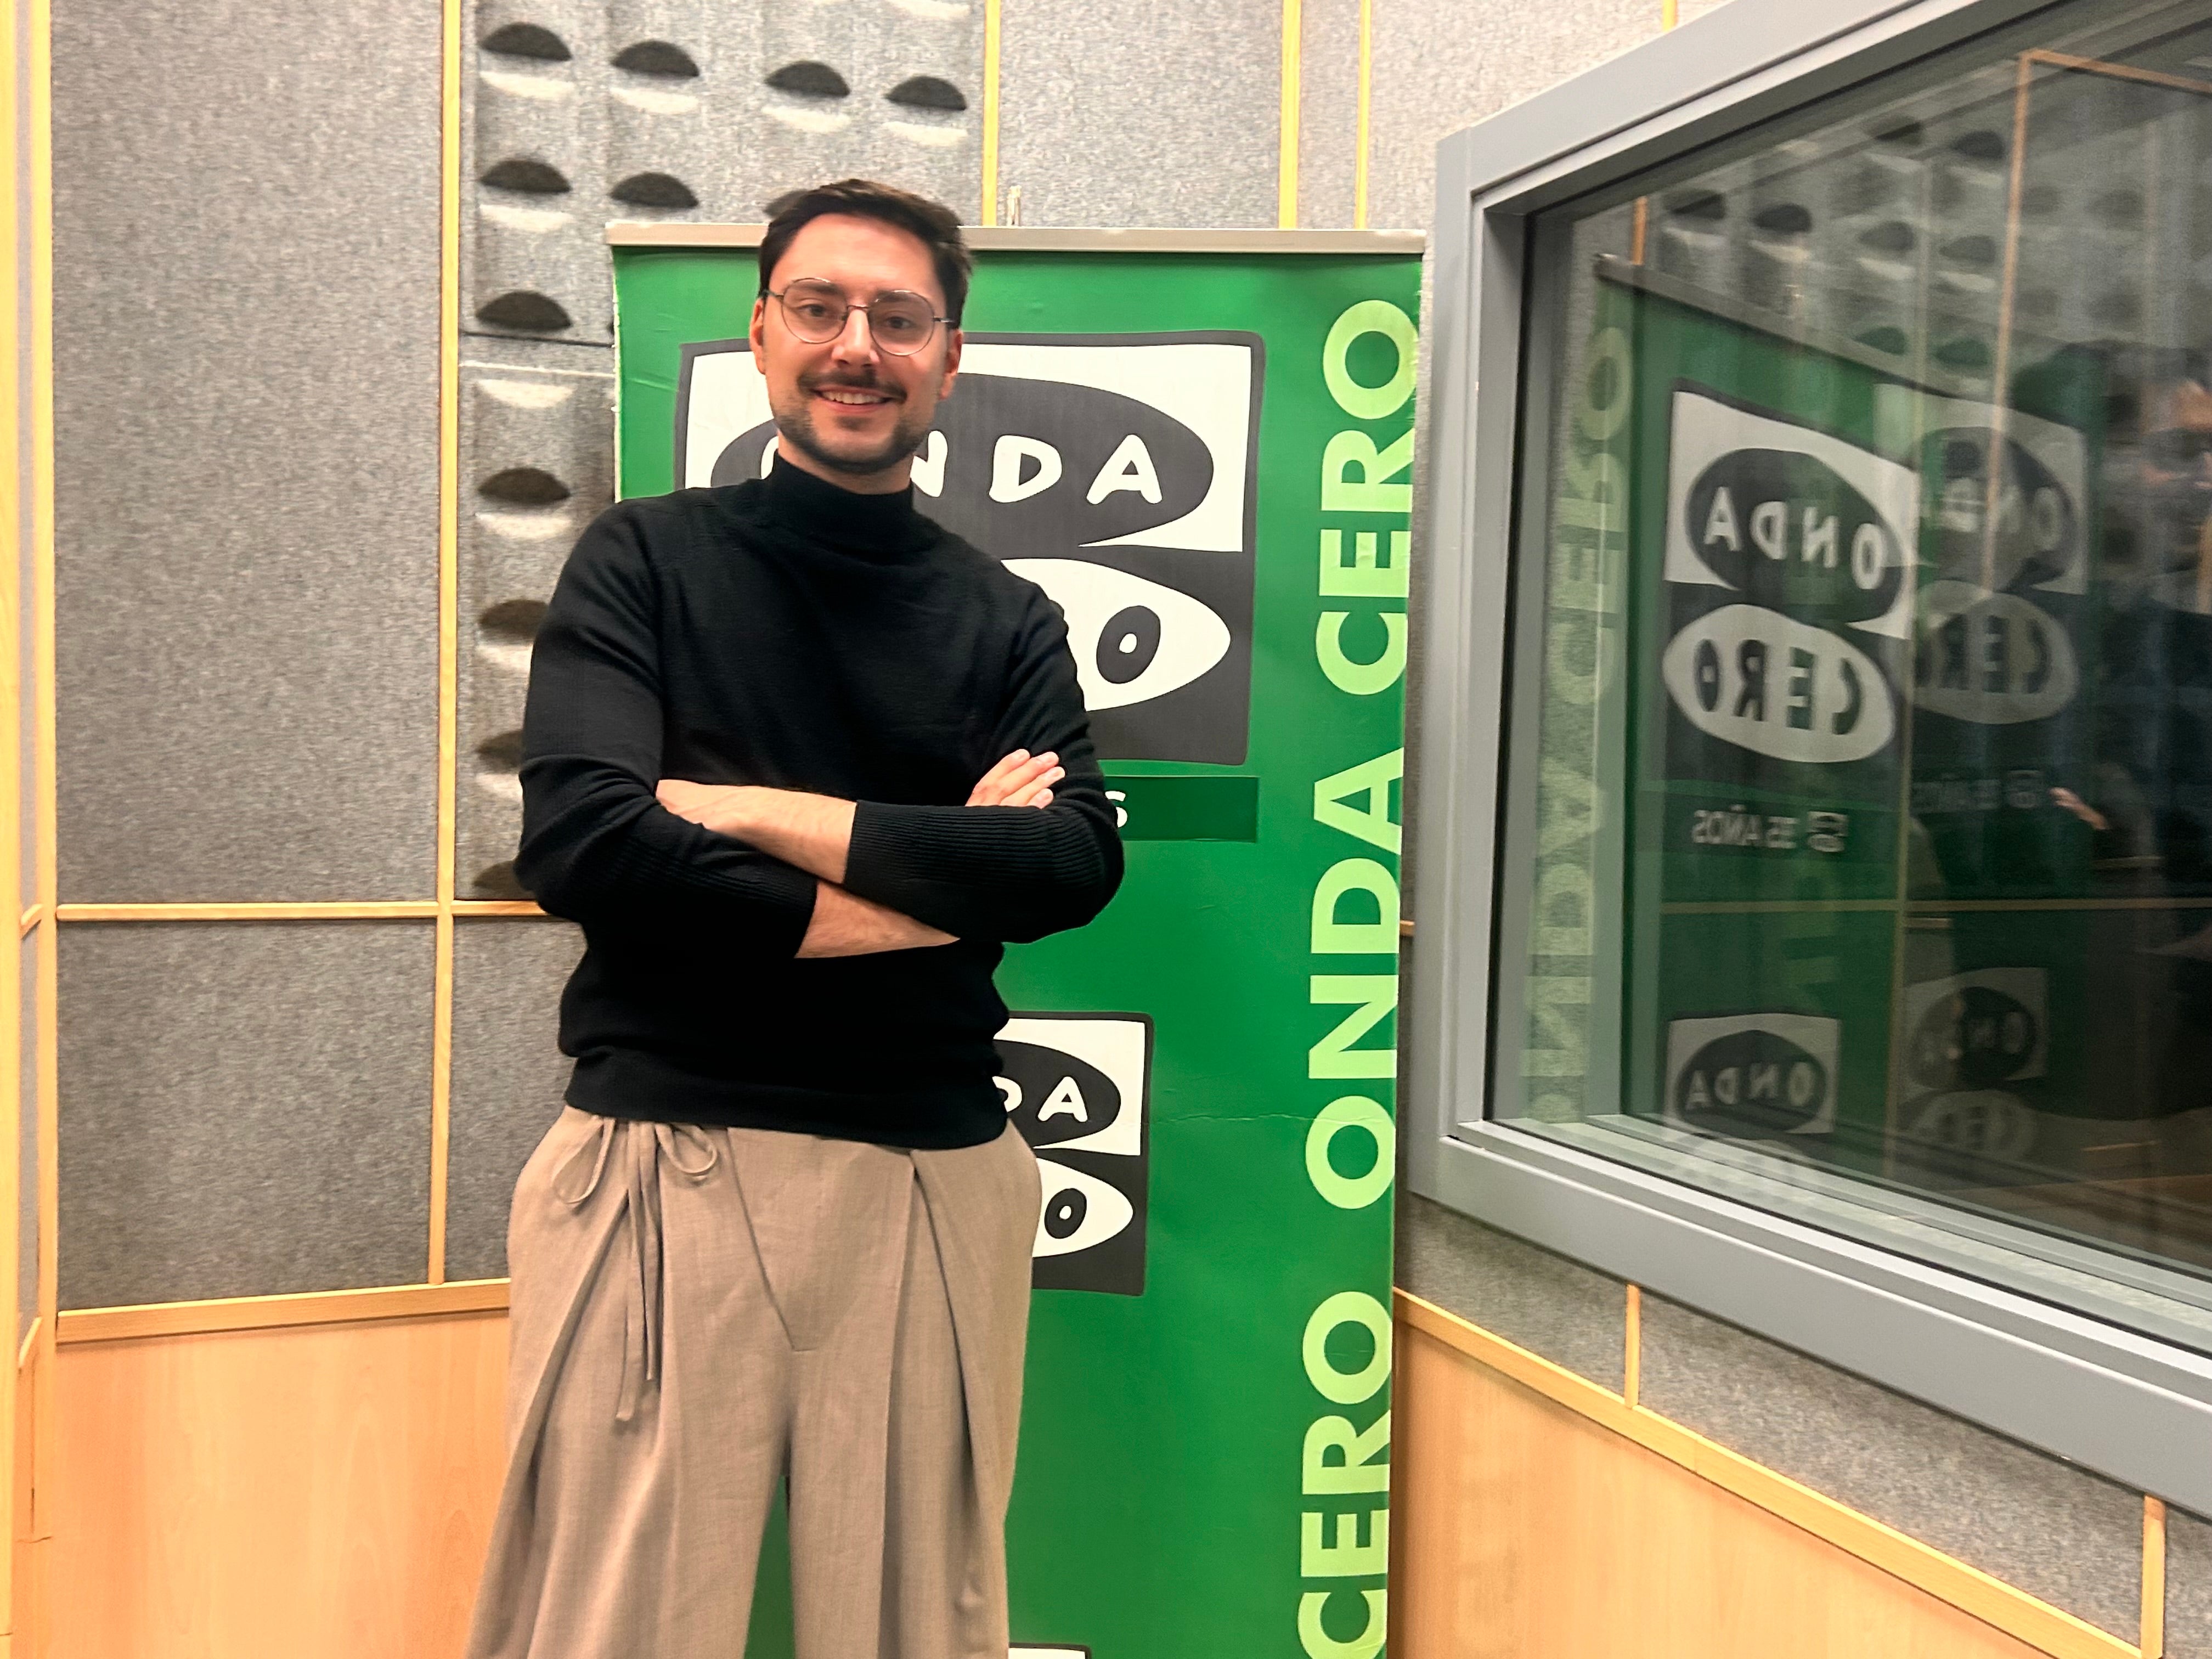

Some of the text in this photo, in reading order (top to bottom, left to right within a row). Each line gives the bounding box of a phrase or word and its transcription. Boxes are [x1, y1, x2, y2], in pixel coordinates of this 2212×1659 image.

[760, 430, 1163, 505] NDA
[1297, 300, 1419, 1659] CERO ONDA CERO
